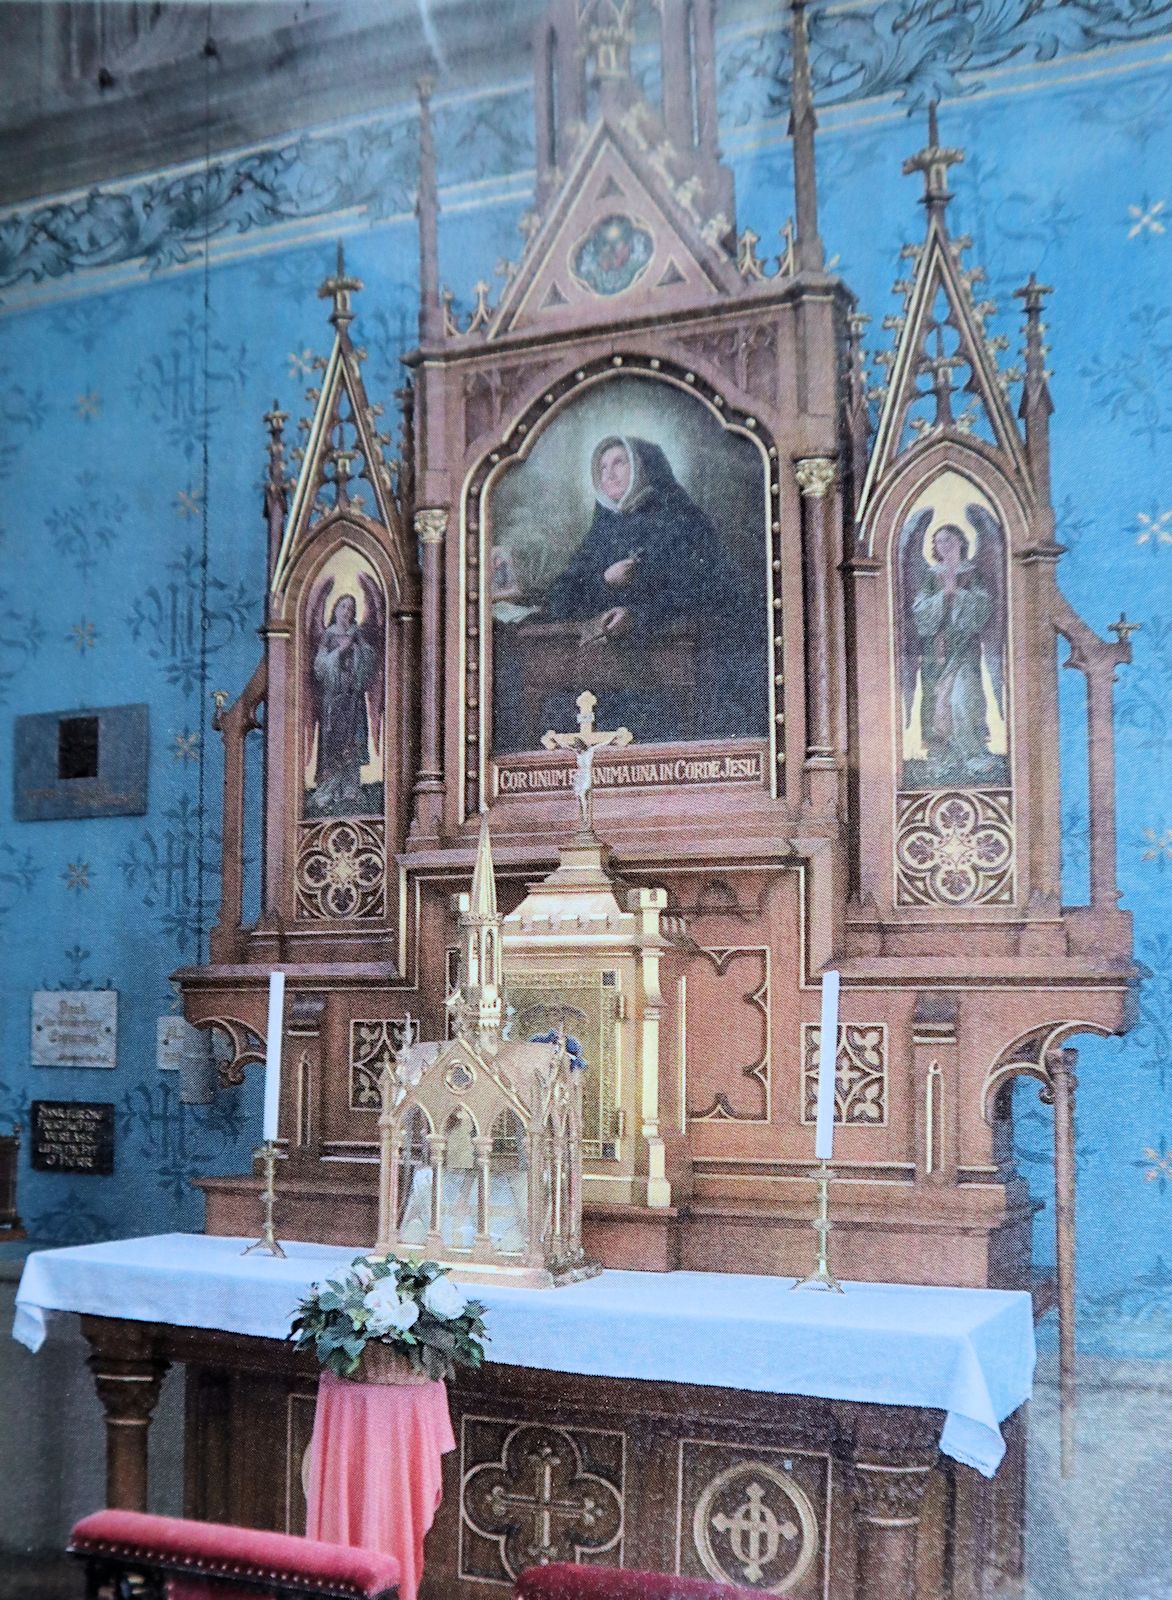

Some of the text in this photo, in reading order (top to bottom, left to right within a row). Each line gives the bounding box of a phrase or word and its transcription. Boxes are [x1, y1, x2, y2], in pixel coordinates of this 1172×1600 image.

[500, 770, 528, 790] COR
[528, 767, 568, 789] UNUM
[631, 763, 659, 783] UNA
[659, 762, 674, 781] IN
[674, 759, 720, 780] CORDE
